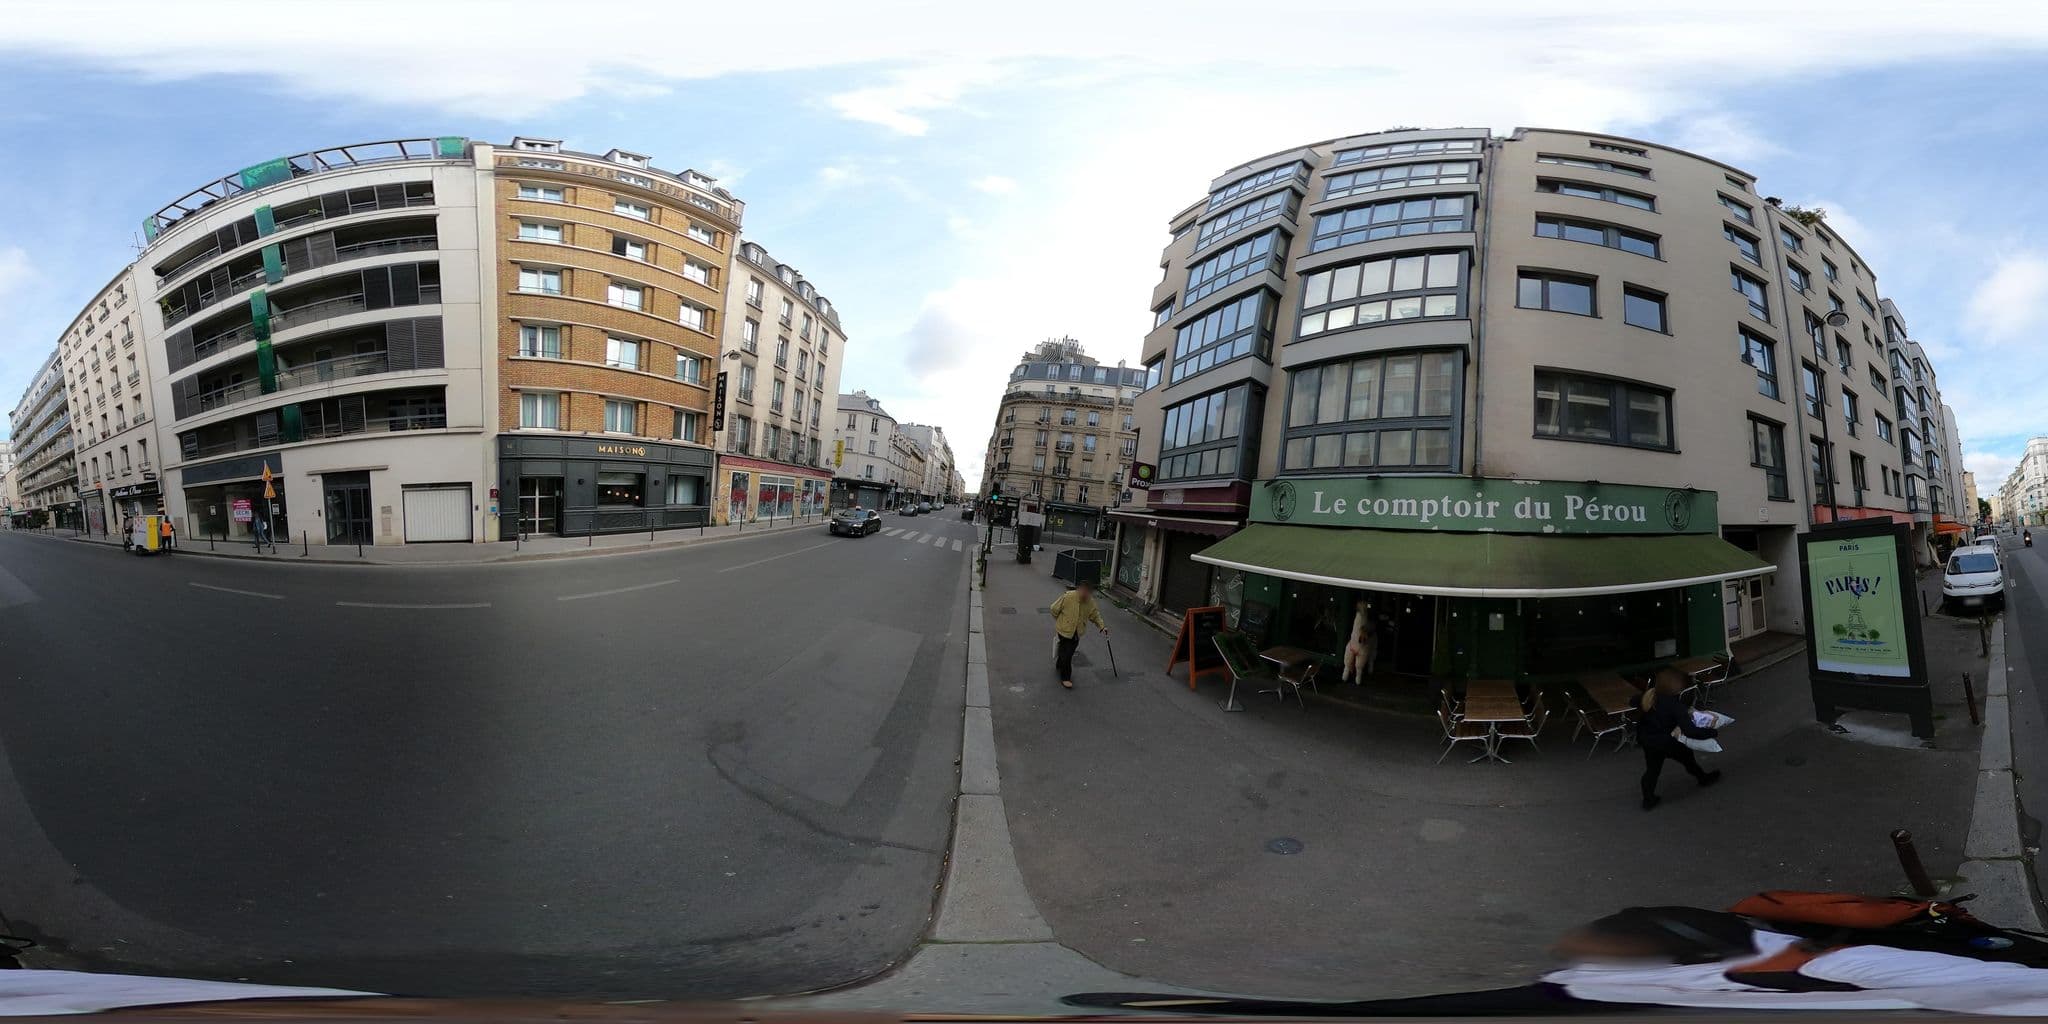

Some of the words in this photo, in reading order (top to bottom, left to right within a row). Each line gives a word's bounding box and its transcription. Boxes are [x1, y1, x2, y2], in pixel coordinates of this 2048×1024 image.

[1312, 491, 1347, 514] Le
[1357, 491, 1500, 523] comptoir
[1514, 496, 1552, 520] du
[1564, 495, 1647, 523] Pérou
[1839, 544, 1860, 552] PARIS
